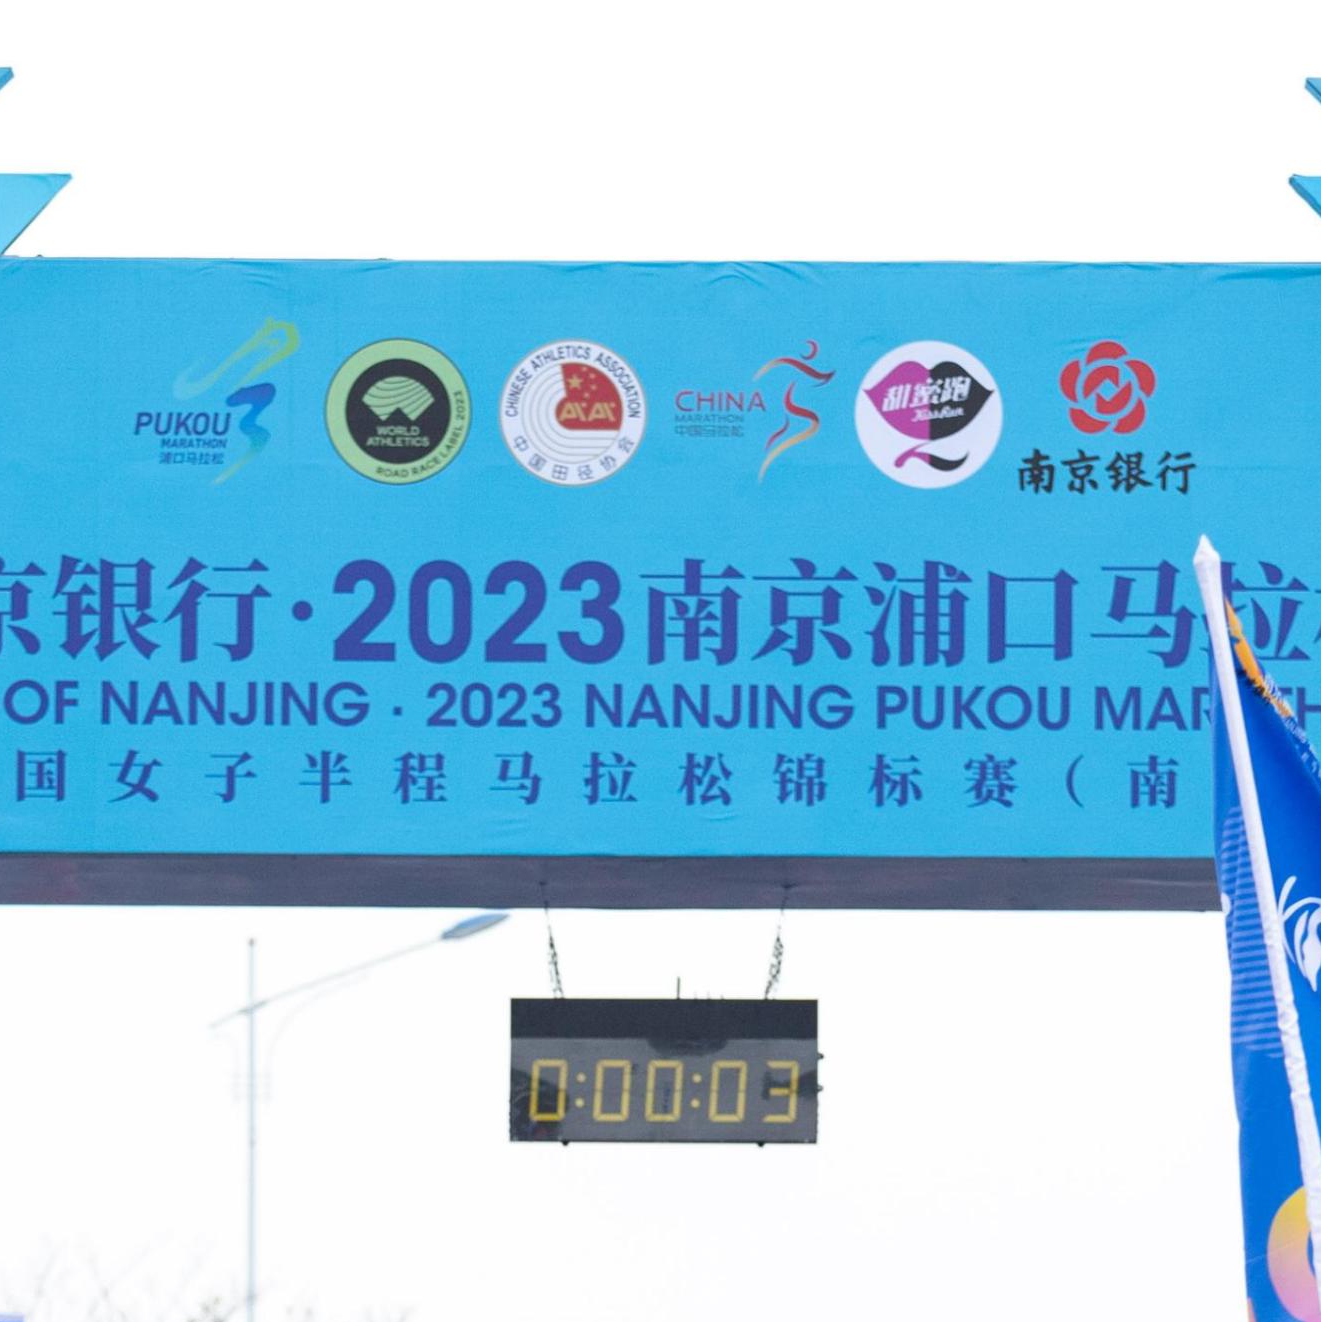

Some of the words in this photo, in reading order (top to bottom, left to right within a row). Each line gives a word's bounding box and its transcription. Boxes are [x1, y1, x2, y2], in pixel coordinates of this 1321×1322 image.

[505, 367, 532, 418] CHINESE
[531, 345, 591, 372] ATHLETICS
[594, 351, 642, 419] ASSOCIATION
[674, 415, 745, 424] MARATHON
[675, 390, 766, 412] CHINA
[133, 410, 232, 437] PUKOU
[376, 426, 420, 436] WORLD
[160, 438, 229, 450] MARATHON
[365, 437, 430, 448] ATHLETICS
[375, 464, 410, 479] ROAD
[411, 456, 441, 478] RACE
[441, 424, 465, 464] LABEL
[514, 434, 635, 481] 中国田径协会
[1018, 447, 1197, 496] 南京银行
[3, 678, 80, 725] OF
[100, 679, 370, 727] NANJING
[426, 681, 563, 729] 2023
[584, 683, 855, 731] NANJING
[878, 684, 1071, 731] PUKOU
[529, 1059, 799, 1123] 0:00:03
